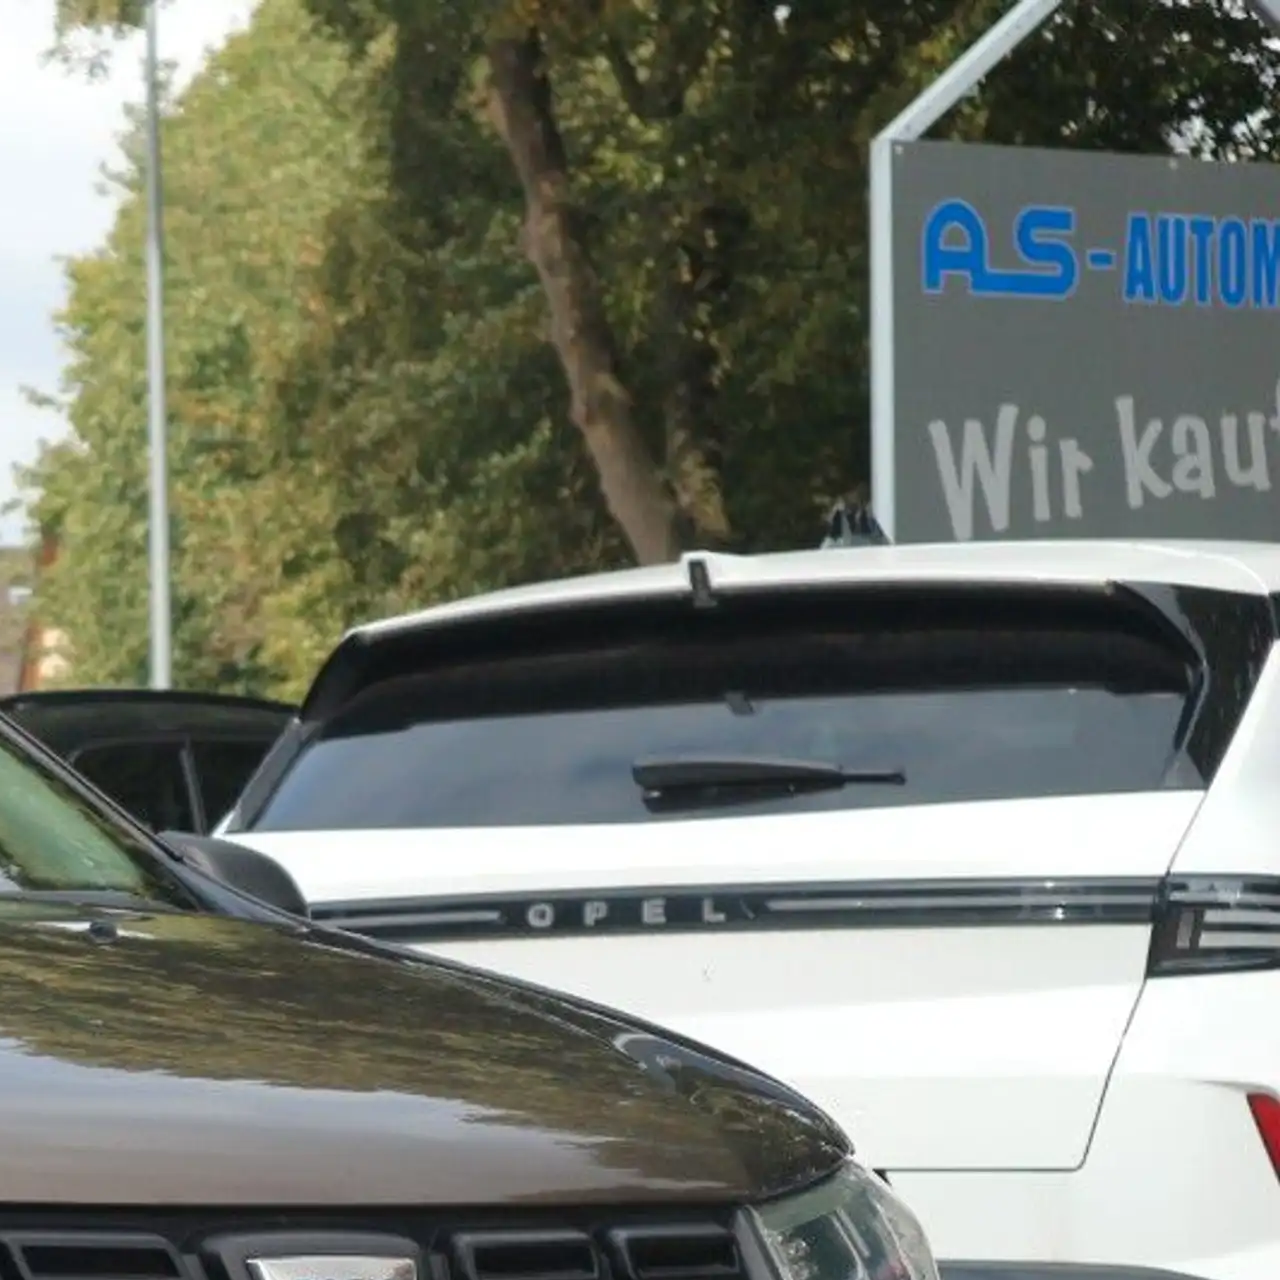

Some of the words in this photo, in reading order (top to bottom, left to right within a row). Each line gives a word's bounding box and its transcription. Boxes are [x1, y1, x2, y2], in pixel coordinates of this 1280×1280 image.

[927, 402, 1094, 542] Wir
[1114, 376, 1280, 510] kau
[526, 897, 726, 928] OPEL
